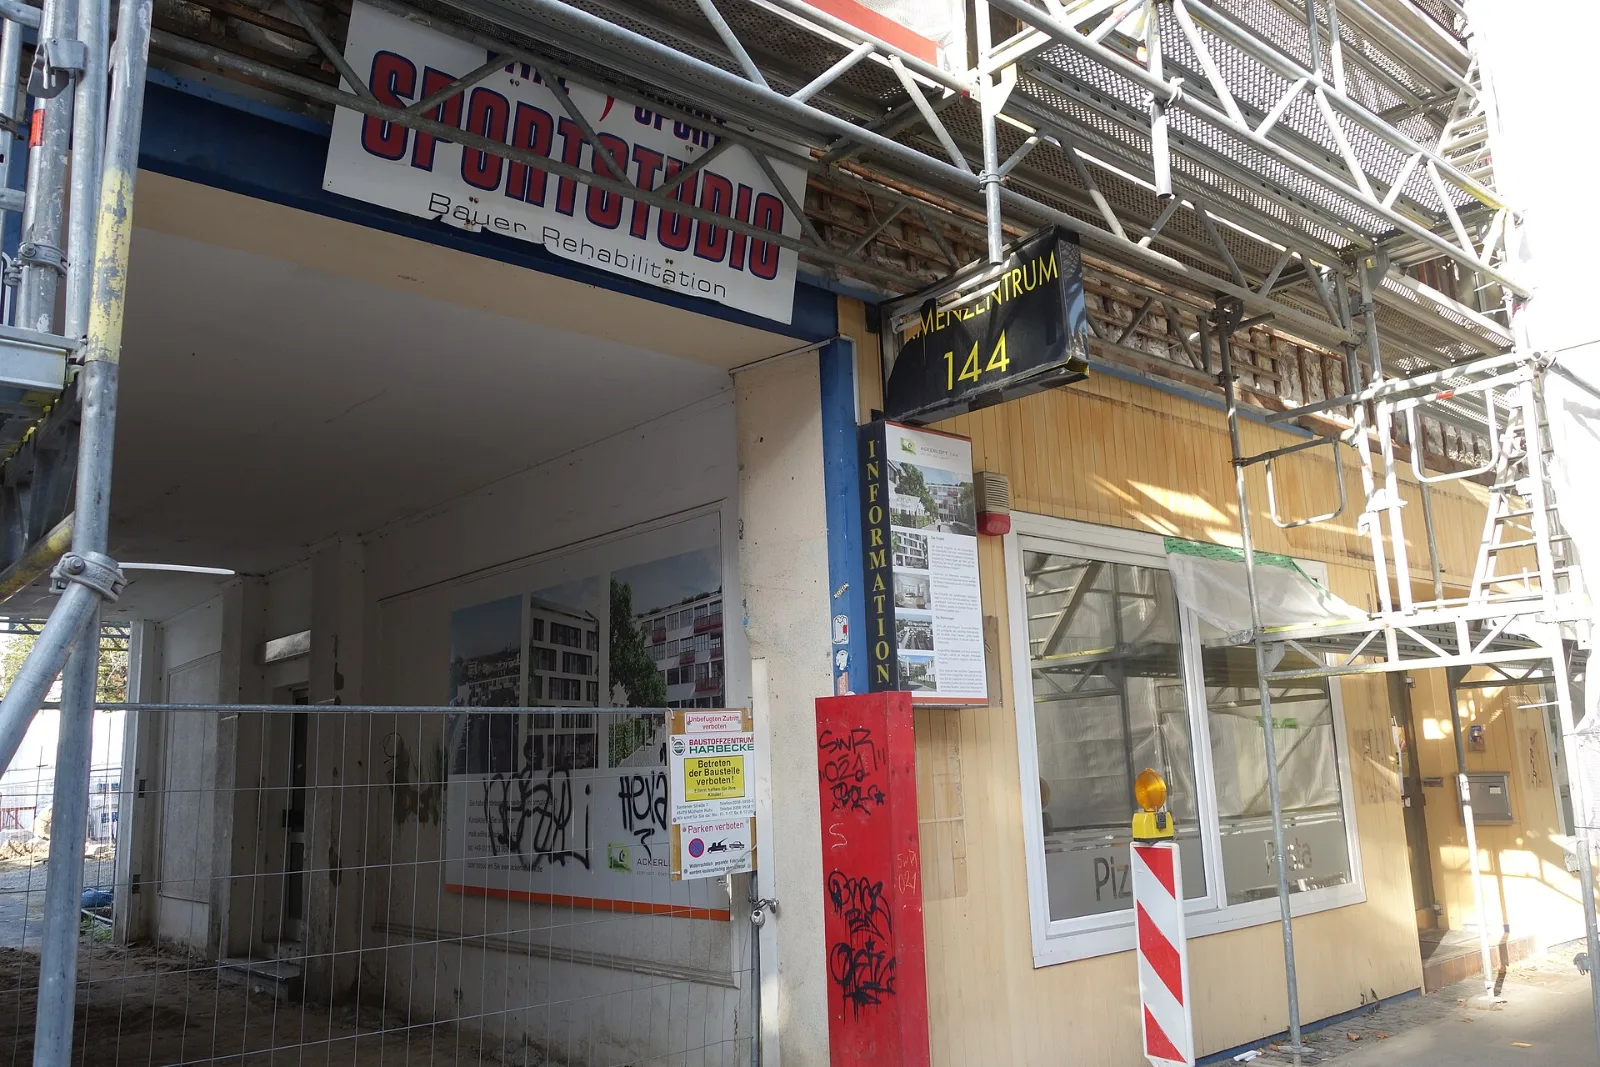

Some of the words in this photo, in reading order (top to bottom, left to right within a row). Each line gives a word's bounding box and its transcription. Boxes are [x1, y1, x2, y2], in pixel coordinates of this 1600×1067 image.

[361, 50, 784, 281] SPORTSTUDIO
[429, 192, 527, 235] Bauer
[542, 226, 727, 299] Rehabilitation
[943, 329, 1010, 391] 144
[866, 439, 890, 684] INFORMATION
[688, 715, 723, 724] Unbefugten
[689, 737, 754, 746] BAUSTOFFZENTRUM
[689, 744, 754, 754] HARBECKE
[698, 760, 731, 769] Betreten
[688, 769, 702, 778] der
[704, 767, 740, 777] Baustelle
[696, 775, 735, 786] verboten!
[687, 824, 714, 834] Parken
[714, 821, 745, 831] verboten
